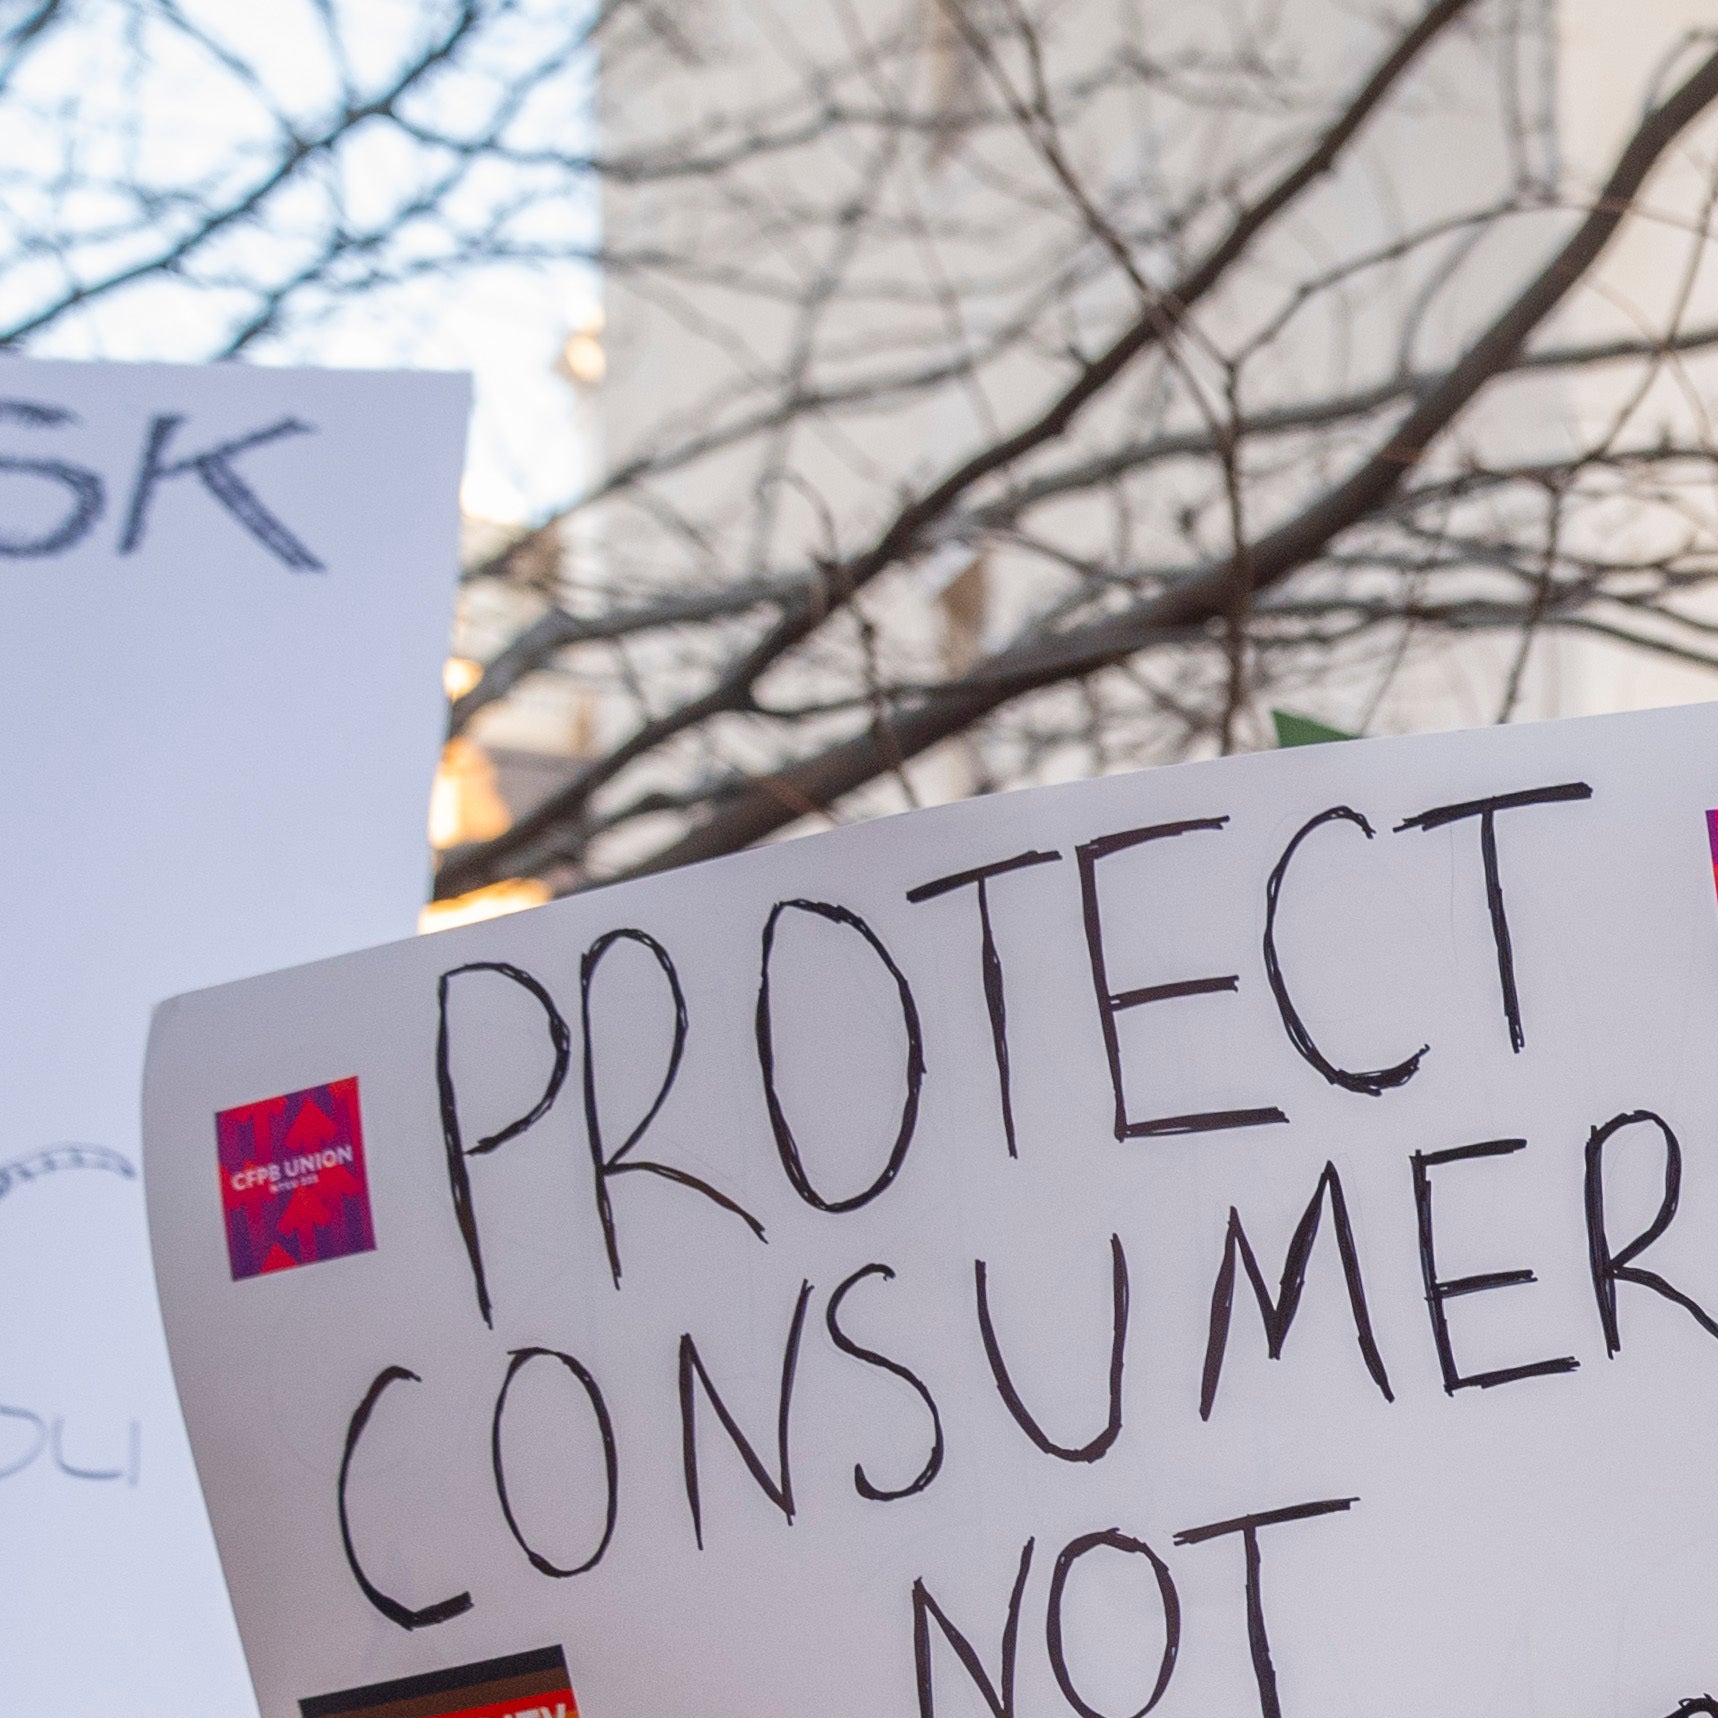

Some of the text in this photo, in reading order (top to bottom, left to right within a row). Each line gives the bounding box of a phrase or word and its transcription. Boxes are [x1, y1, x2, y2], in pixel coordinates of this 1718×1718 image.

[231, 1164, 281, 1191] CFPB
[284, 1145, 353, 1178] UNION
[437, 781, 1593, 1329] PROTECT
